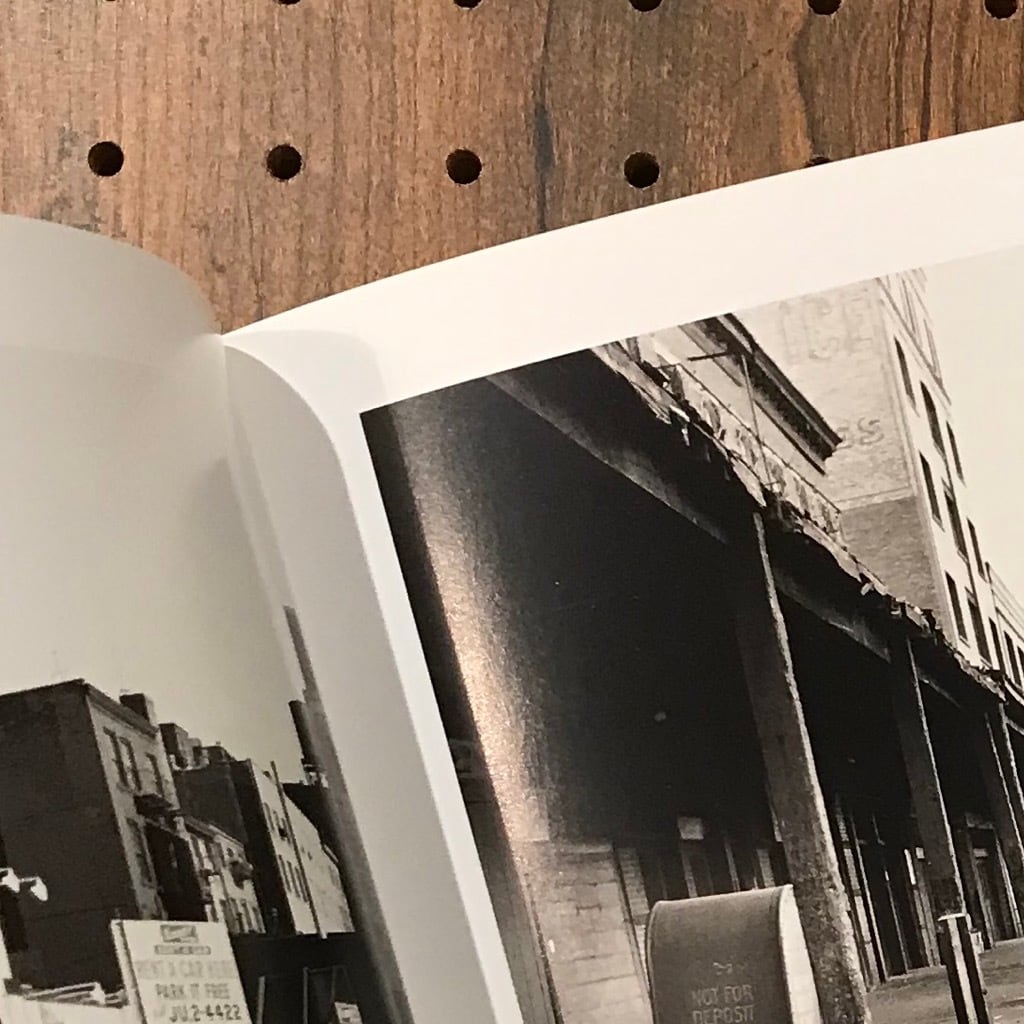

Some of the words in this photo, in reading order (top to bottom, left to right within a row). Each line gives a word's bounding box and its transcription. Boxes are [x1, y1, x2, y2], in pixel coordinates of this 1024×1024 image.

[204, 982, 231, 1000] FREE
[691, 987, 719, 1007] NOT
[724, 984, 754, 1004] FOR
